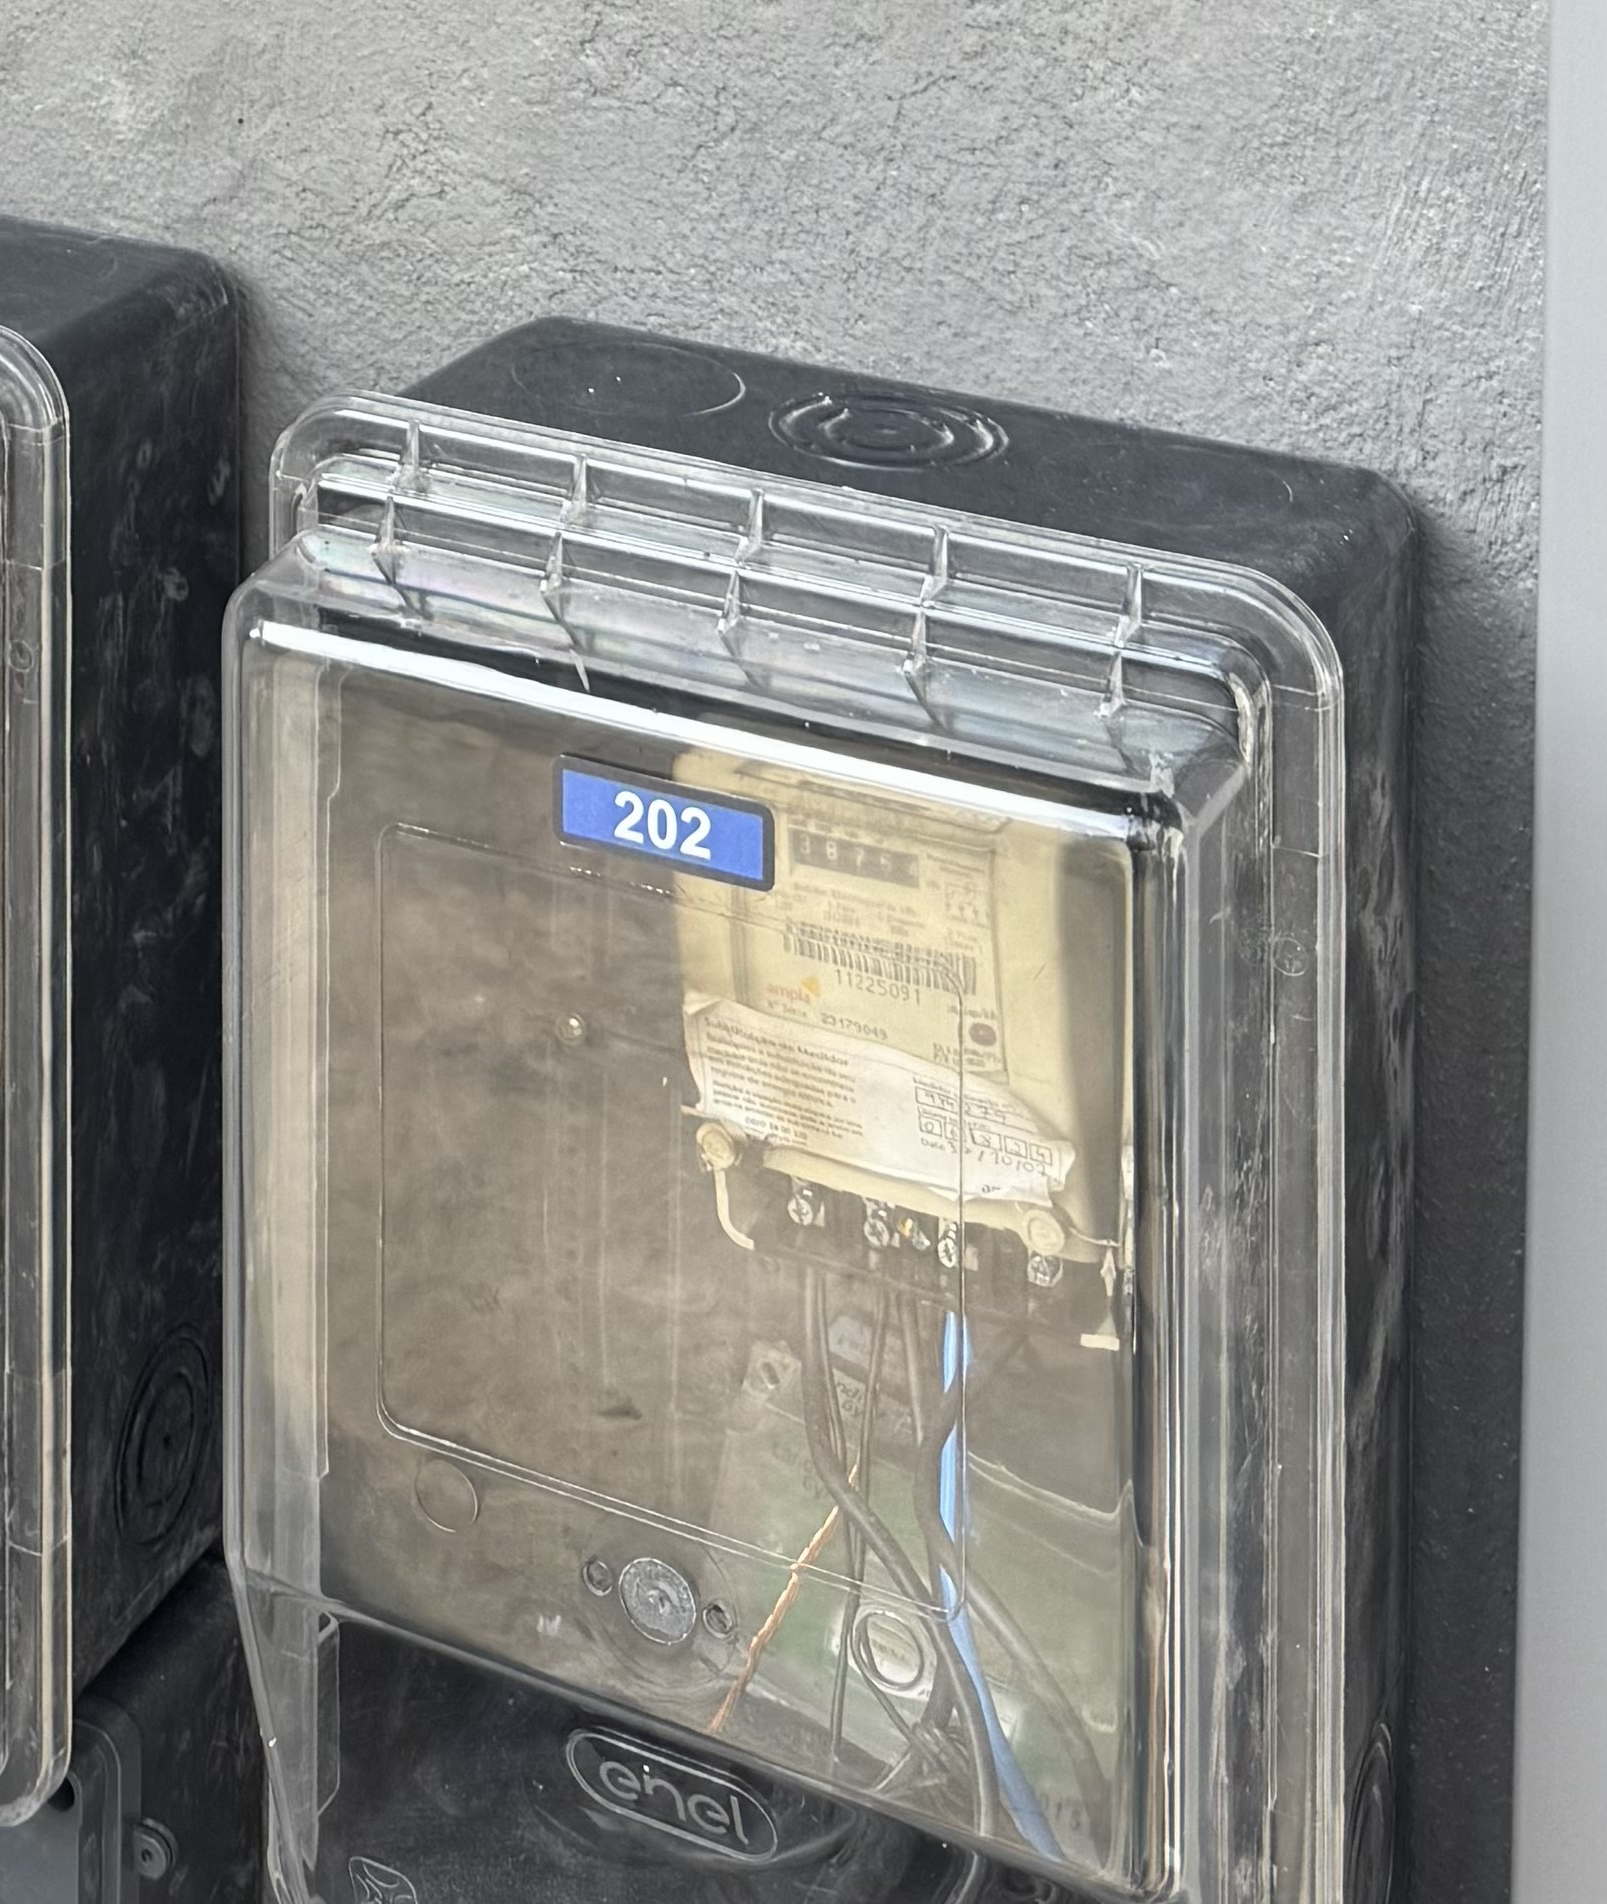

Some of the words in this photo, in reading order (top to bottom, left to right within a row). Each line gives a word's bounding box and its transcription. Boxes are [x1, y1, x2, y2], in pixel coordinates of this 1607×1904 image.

[614, 791, 712, 861] 202
[835, 968, 922, 1006] 11225091
[599, 1760, 749, 1846] enel
